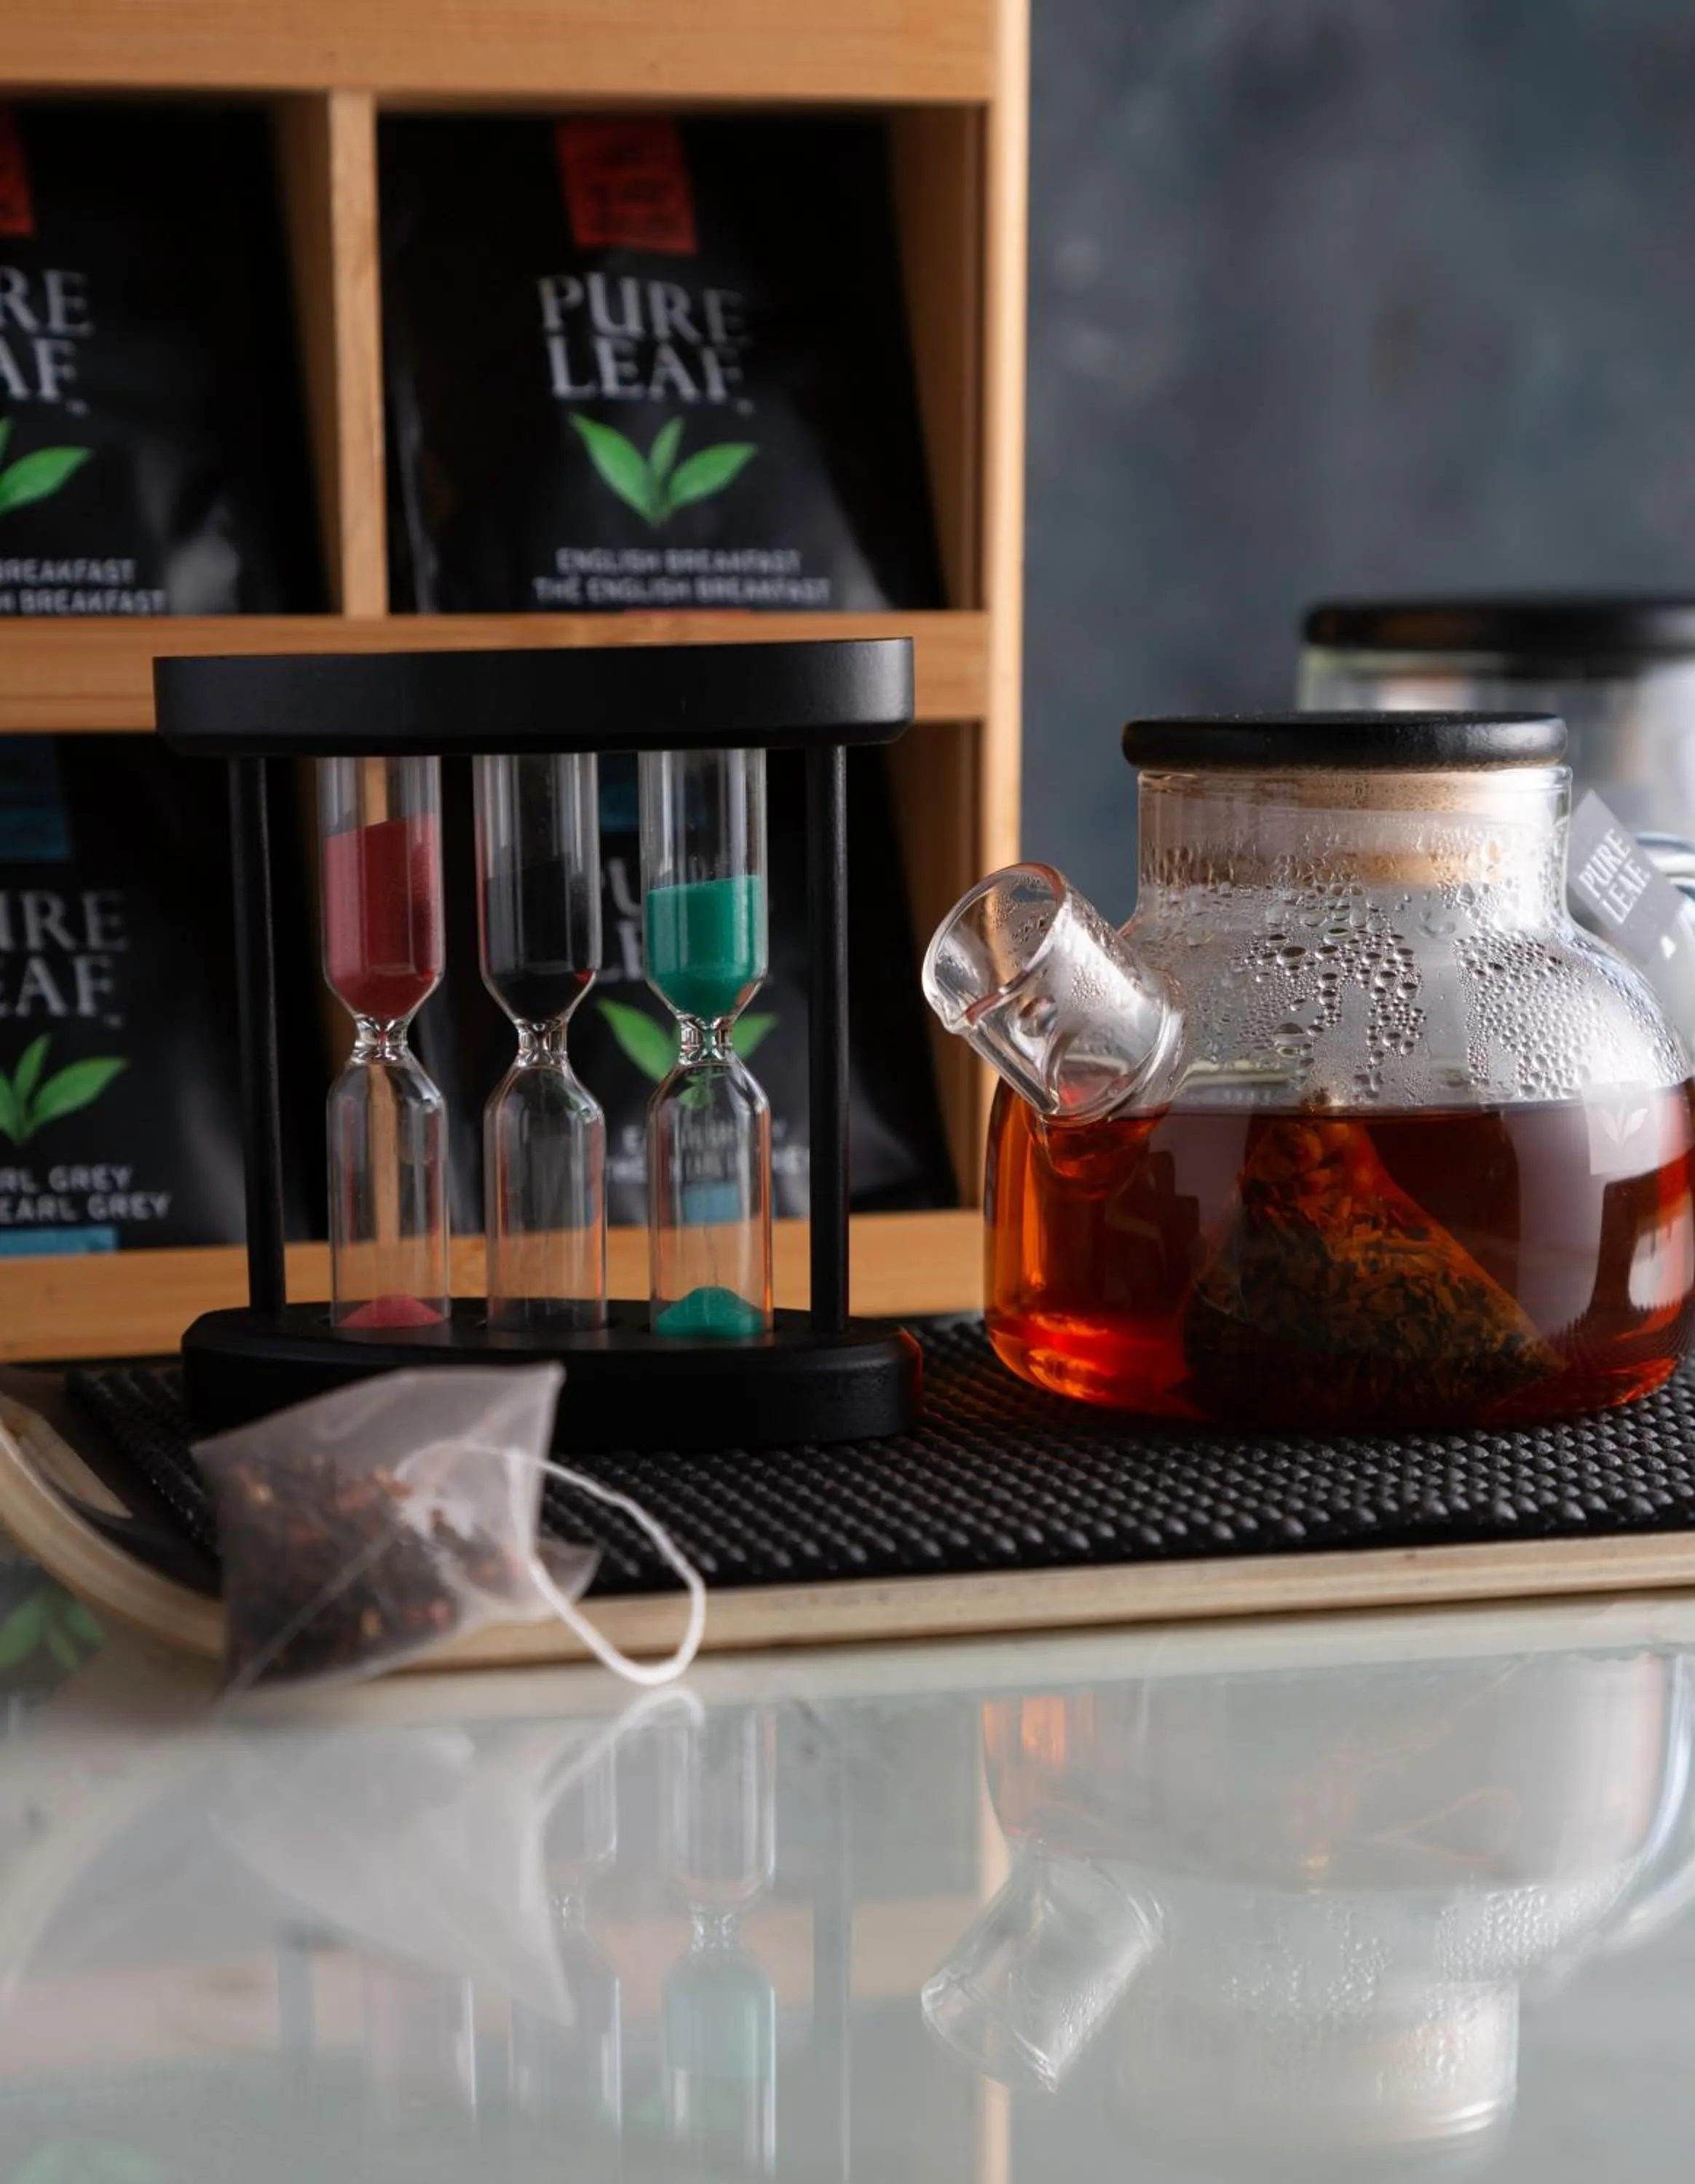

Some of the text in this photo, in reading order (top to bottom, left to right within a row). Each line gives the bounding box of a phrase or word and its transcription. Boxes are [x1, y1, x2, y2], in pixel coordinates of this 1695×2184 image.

[0, 265, 94, 336] RE
[538, 272, 750, 345] PURE
[0, 558, 136, 585] REAKFAST
[19, 588, 165, 614] BREAKFAST
[1579, 828, 1631, 900] PURE
[1602, 858, 1653, 925] LEAF
[0, 890, 127, 951] RE
[0, 1163, 133, 1193] RL GREY
[87, 1191, 172, 1221] GREY
